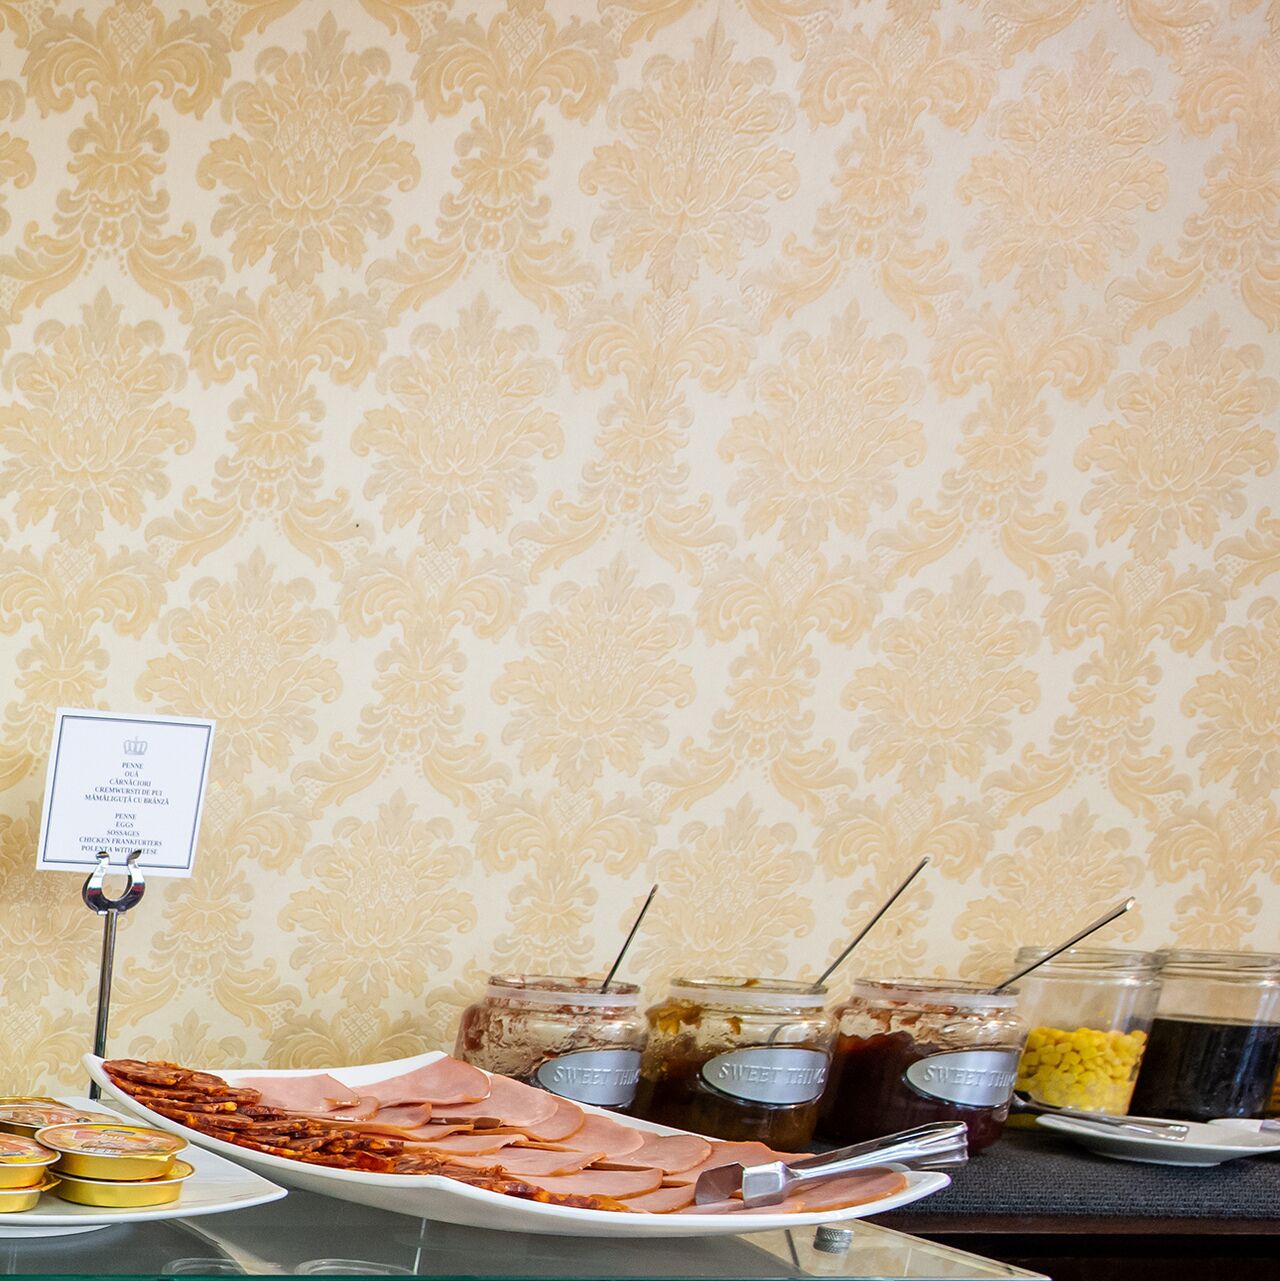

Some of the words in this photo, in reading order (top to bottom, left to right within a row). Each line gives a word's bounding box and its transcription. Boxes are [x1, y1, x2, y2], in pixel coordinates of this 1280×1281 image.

[111, 838, 163, 846] FRANKFURTERS
[553, 1065, 612, 1085] SWEET
[718, 1063, 783, 1083] SWEET
[924, 1065, 987, 1086] SWEET
